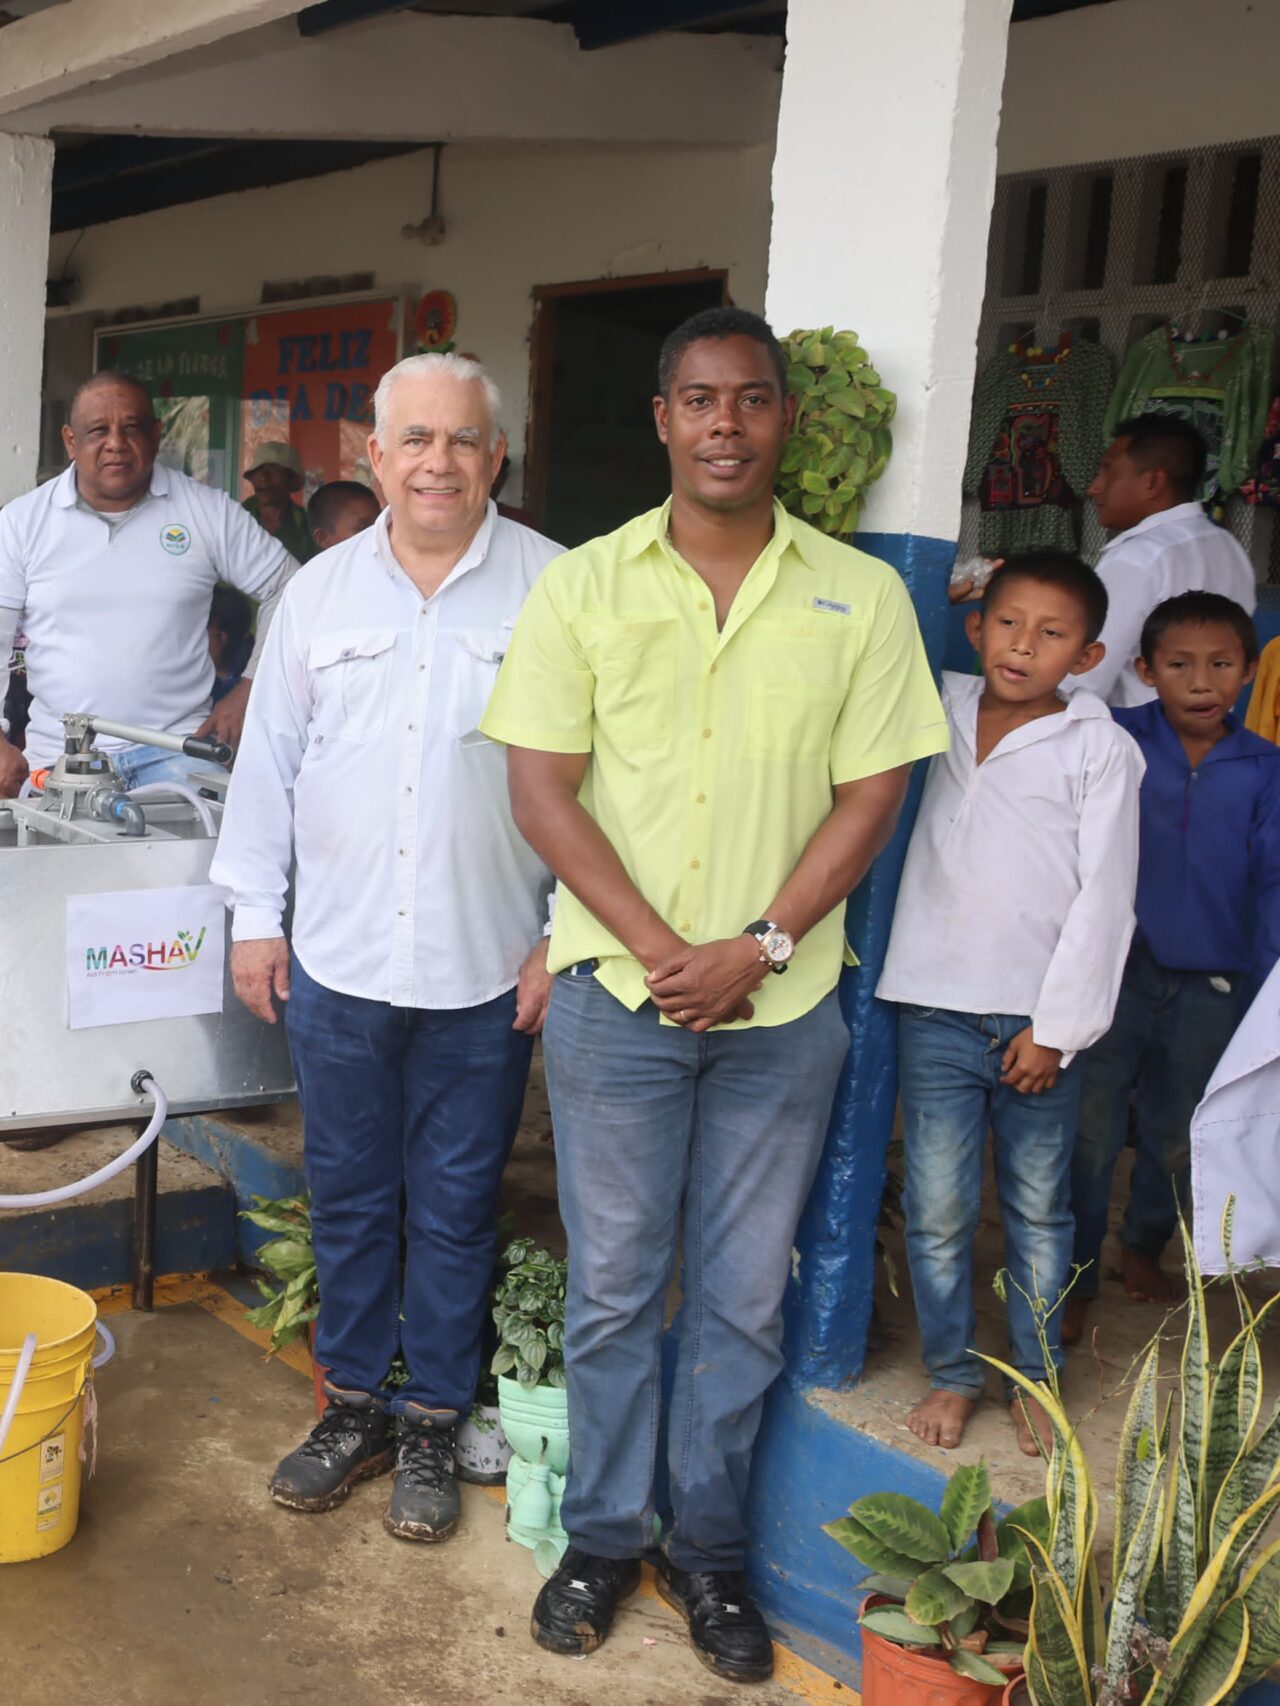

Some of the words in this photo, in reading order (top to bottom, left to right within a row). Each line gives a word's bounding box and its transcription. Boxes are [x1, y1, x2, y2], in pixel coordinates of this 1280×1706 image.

[277, 329, 372, 374] FELIZ
[324, 382, 376, 424] DE
[86, 926, 207, 970] MASHAV
